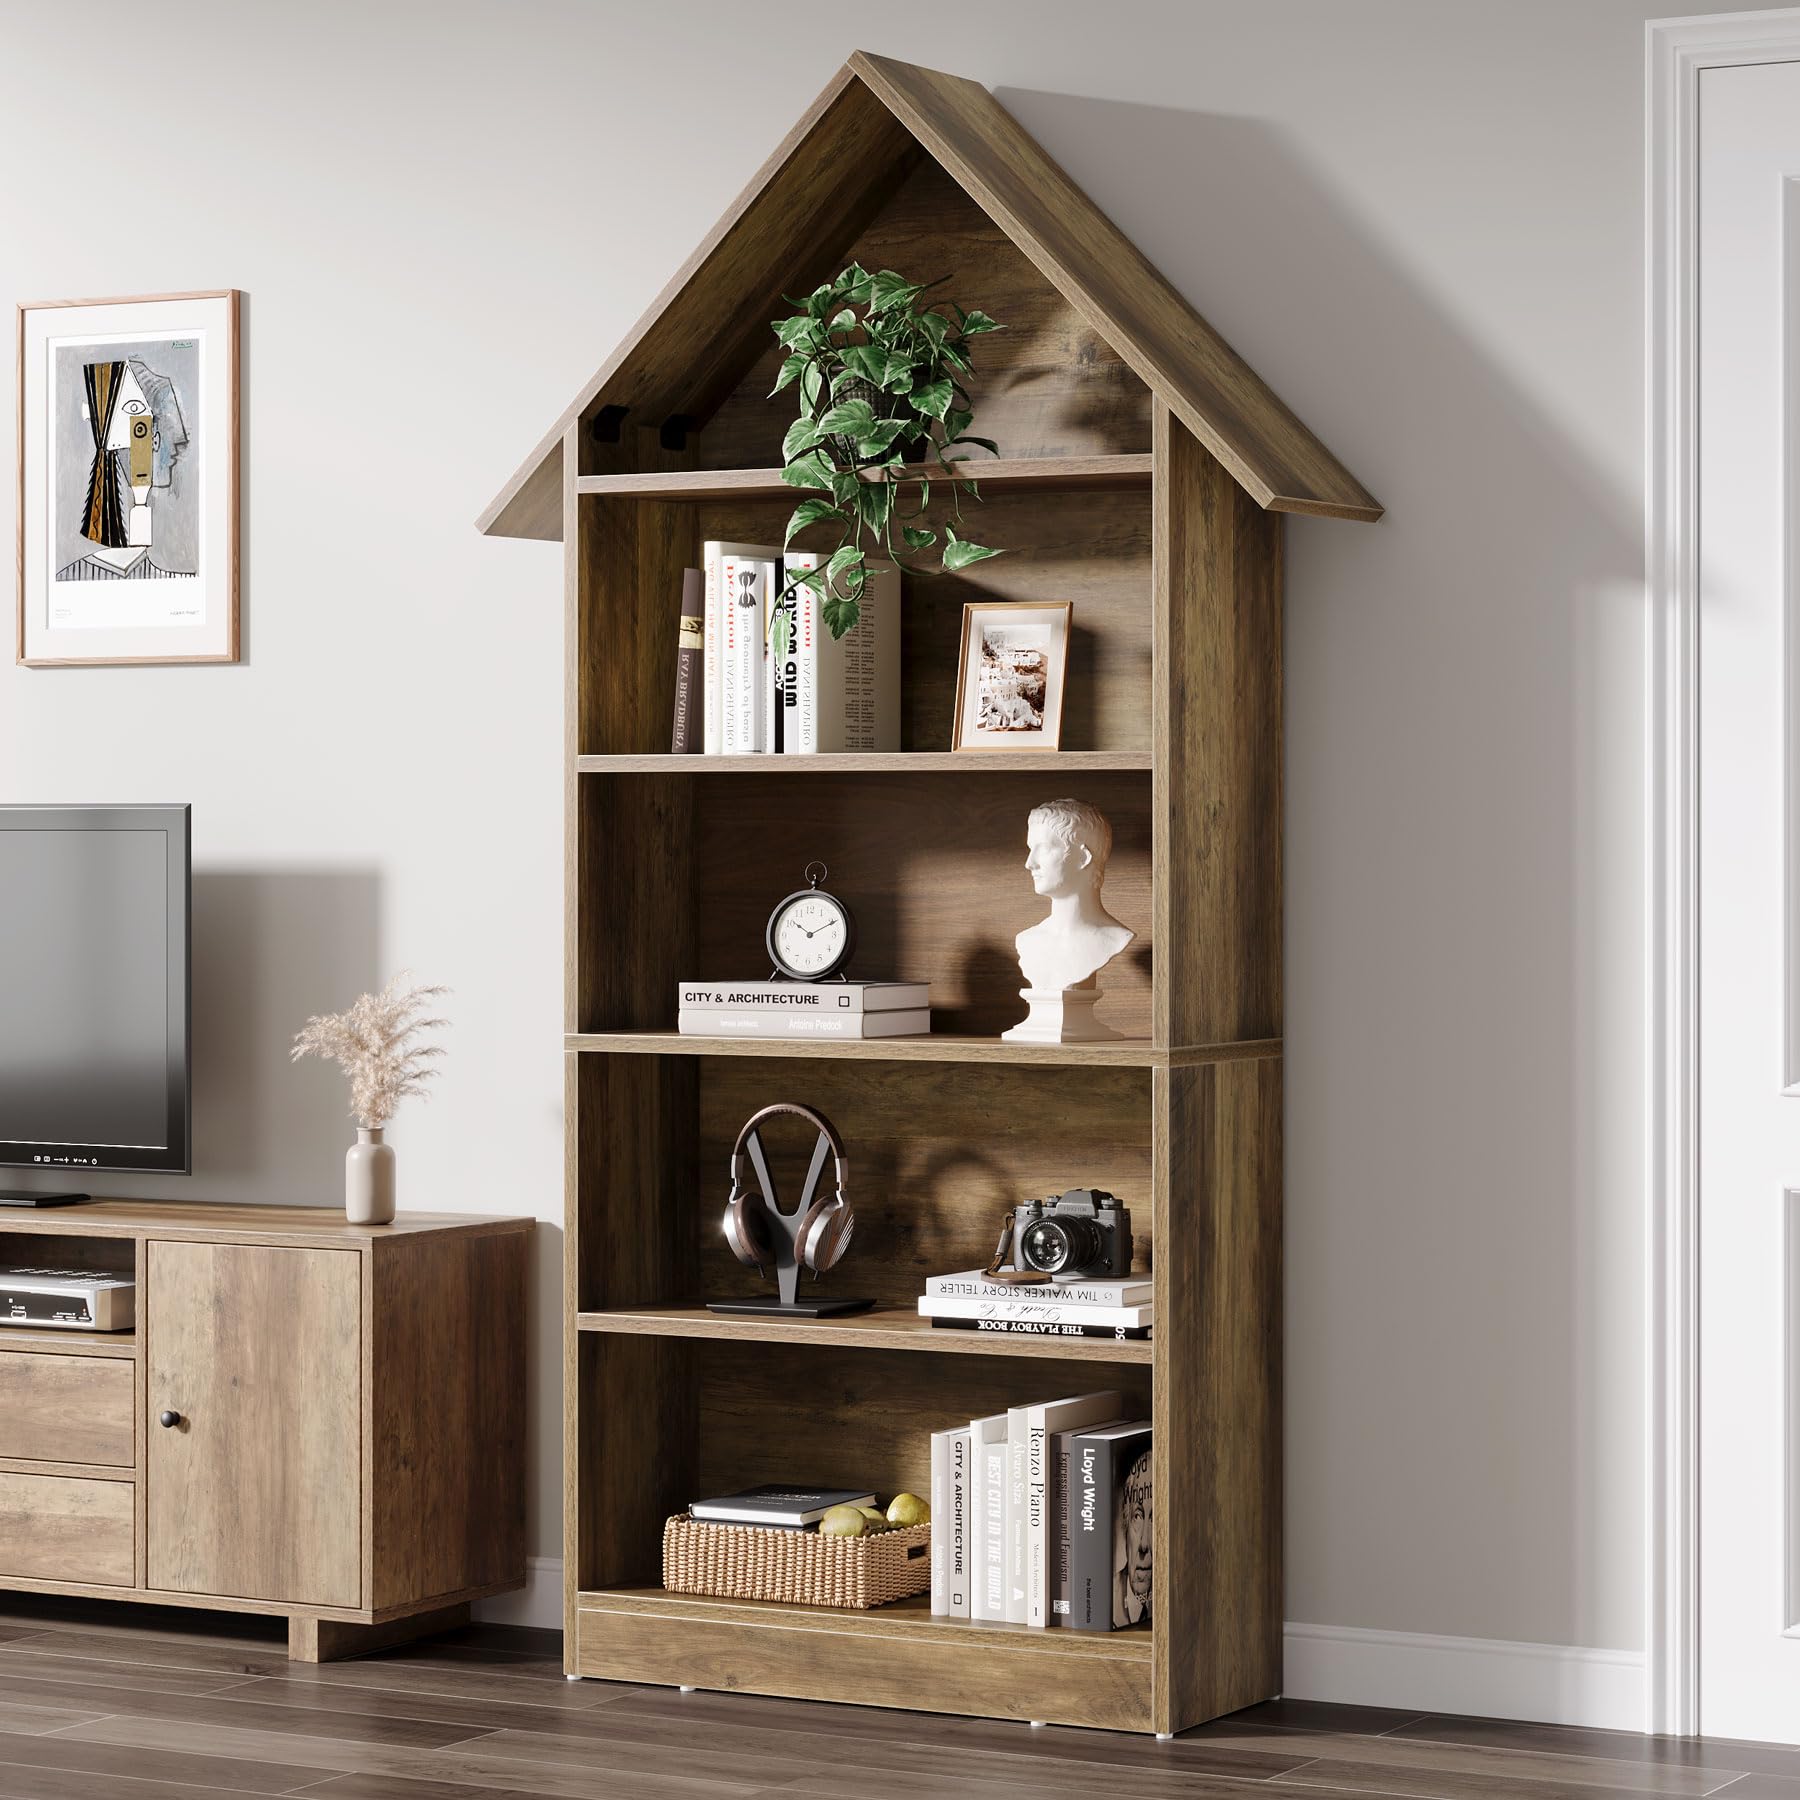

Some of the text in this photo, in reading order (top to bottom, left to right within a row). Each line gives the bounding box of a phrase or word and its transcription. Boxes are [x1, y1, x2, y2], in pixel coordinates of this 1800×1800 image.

[785, 661, 797, 707] WILD
[684, 992, 820, 1005] CITY & ARCHITECTURE
[940, 1282, 1098, 1302] TIM WALKER STORY TELLER
[977, 1319, 1084, 1336] THE PLAYBOY BOOK
[986, 1455, 1001, 1487] BEST
[1030, 1427, 1044, 1527] Renzo Piano
[986, 1489, 1001, 1519] CITY
[1012, 1481, 1025, 1505] Siza
[1081, 1448, 1096, 1532] Lloyd Wright
[1123, 1482, 1153, 1505] Wright
[954, 1441, 963, 1575] CITY & ARCHITECTURE
[1060, 1524, 1070, 1541] and
[986, 1539, 1001, 1563] THE
[1060, 1543, 1070, 1583] Fauvism
[986, 1564, 1001, 1611] WORLD
